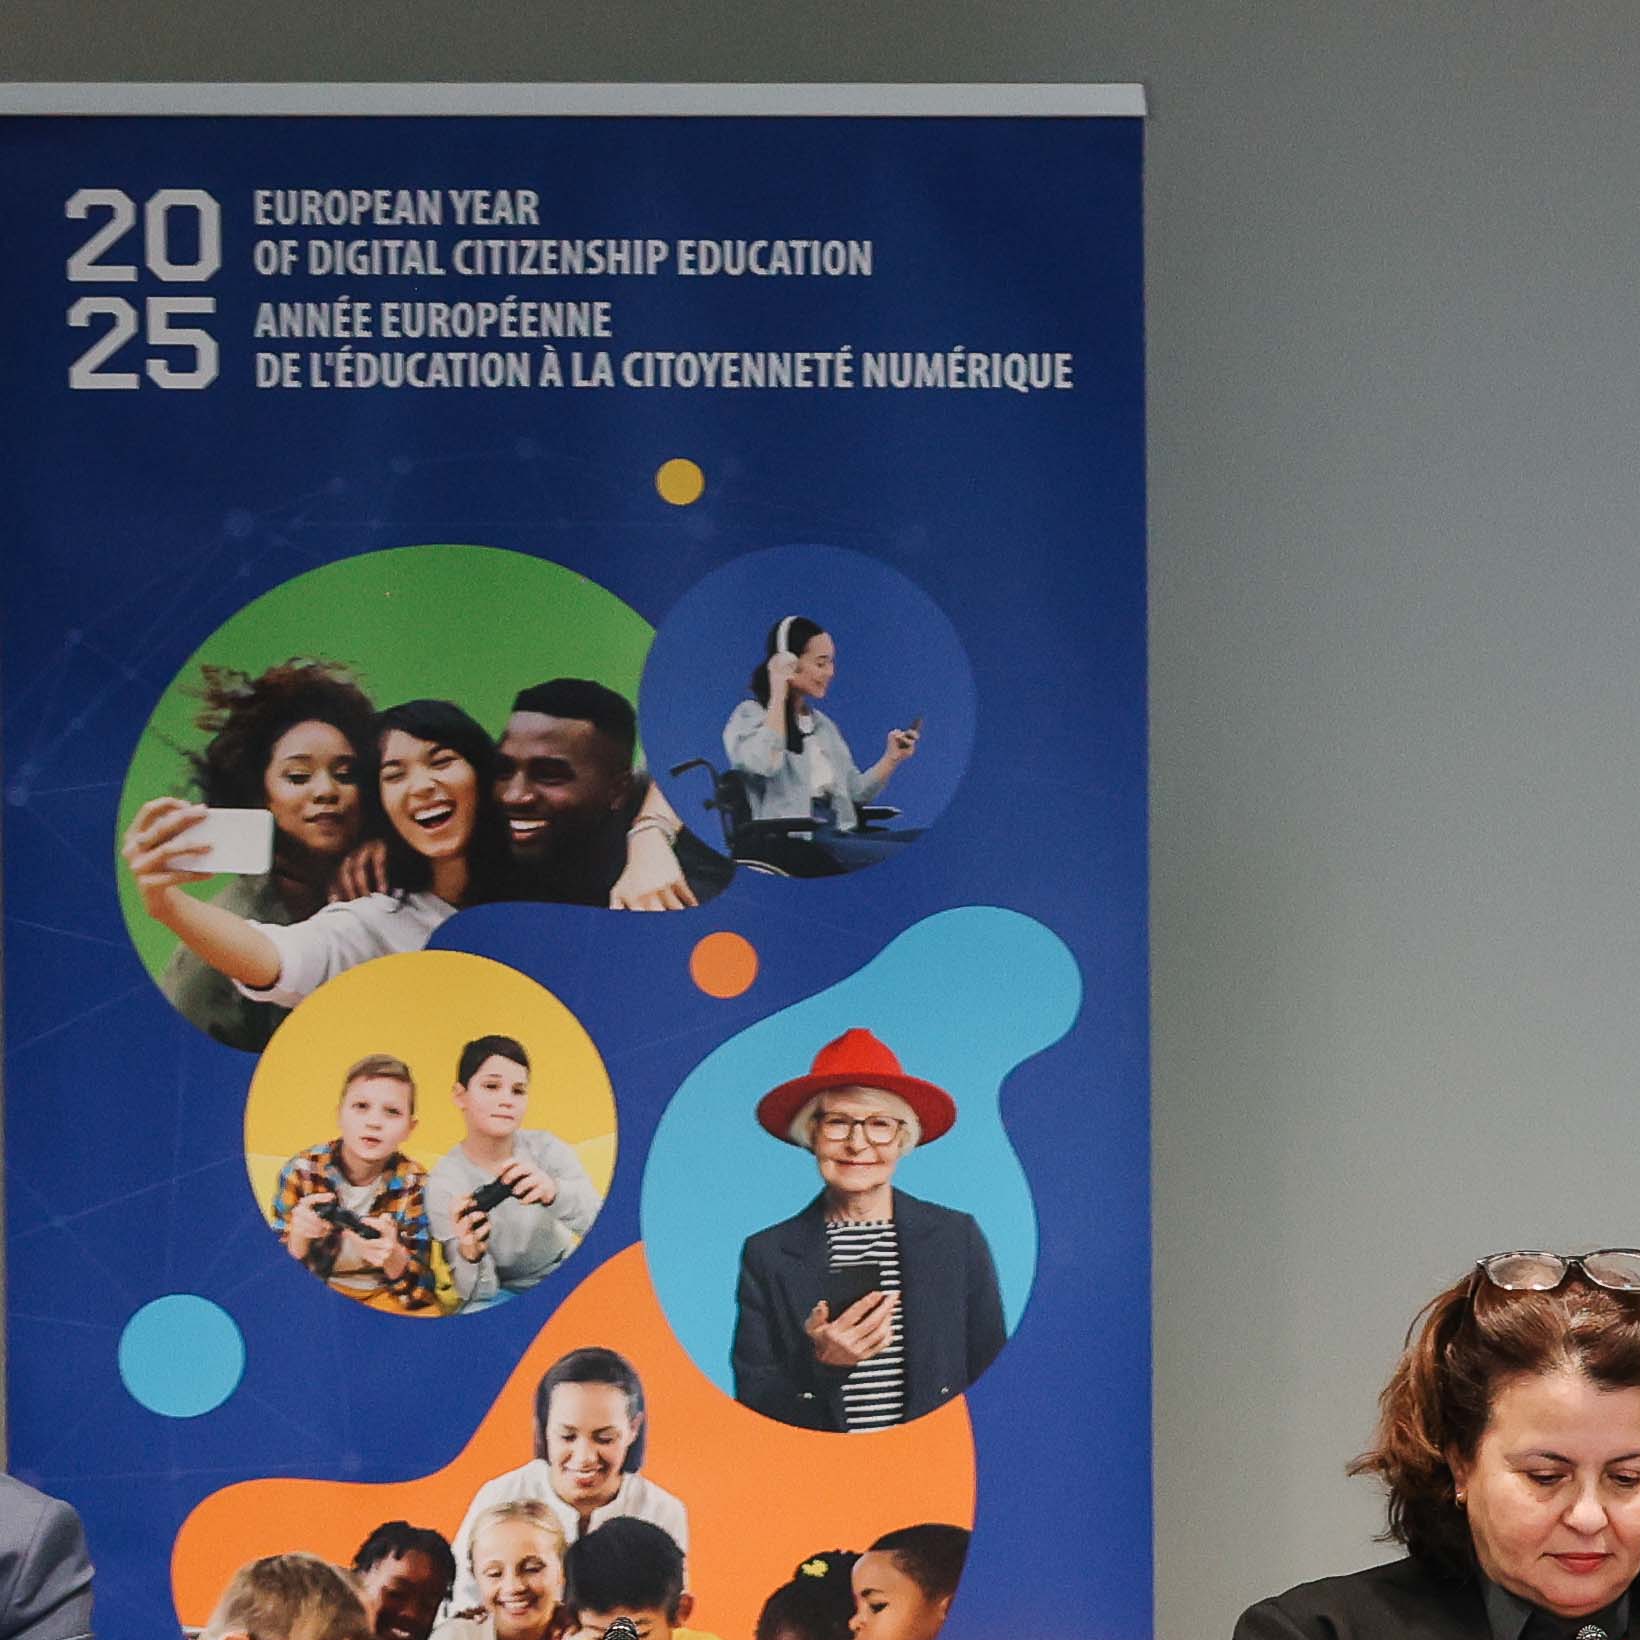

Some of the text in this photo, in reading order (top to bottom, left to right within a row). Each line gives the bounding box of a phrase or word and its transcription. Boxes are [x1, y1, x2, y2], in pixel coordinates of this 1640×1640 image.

[255, 189, 540, 226] EUROPEAN YEAR
[65, 188, 221, 282] 20
[254, 239, 872, 276] OF DIGITAL CITIZENSHIP EDUCATION
[254, 294, 613, 338] ANNÉE EUROPÉENNE
[67, 296, 219, 390] 25
[256, 344, 1074, 393] DE L'ÉDUCATION À LA CITOYENNETÉ NUMÉRIQUE
